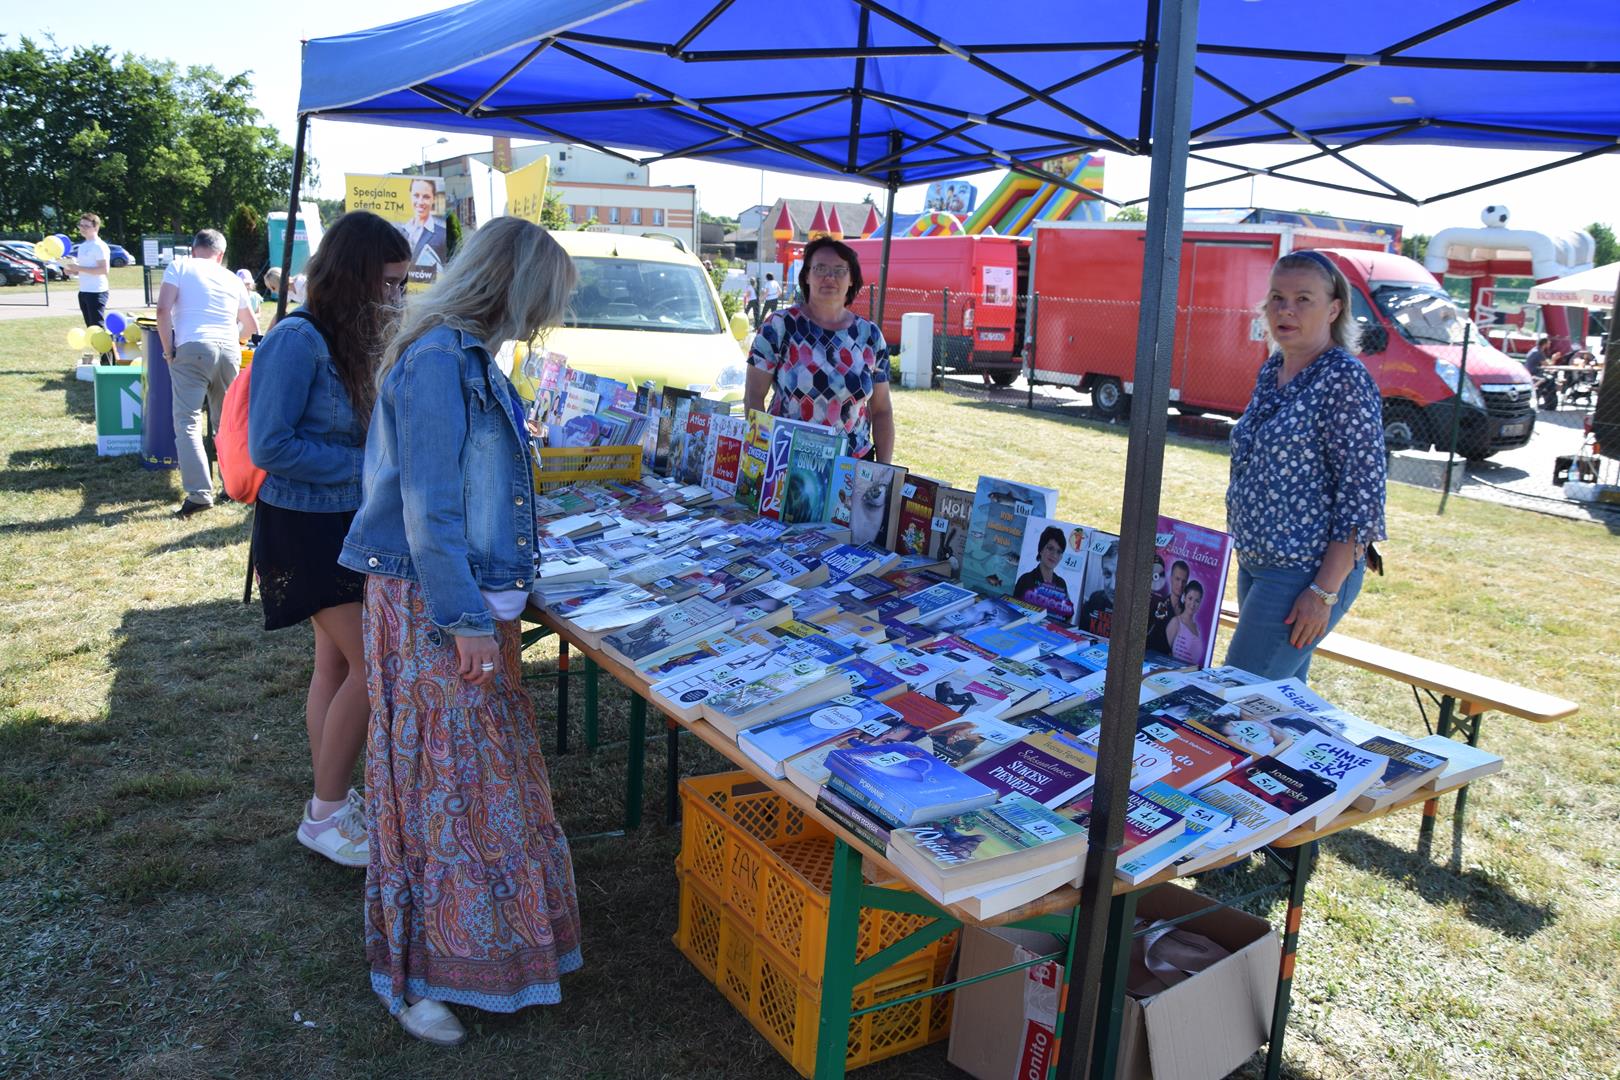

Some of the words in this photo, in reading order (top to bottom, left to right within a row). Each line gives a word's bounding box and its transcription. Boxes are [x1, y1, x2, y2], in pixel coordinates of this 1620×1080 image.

[353, 186, 397, 200] Specjalna
[353, 199, 382, 210] oferta
[383, 201, 405, 212] ZTM
[1191, 546, 1219, 567] tańca
[1174, 753, 1194, 767] do
[988, 766, 1042, 796] PIENIĘDZY
[1270, 768, 1304, 789] Joanna
[1231, 792, 1267, 812] JOANNA
